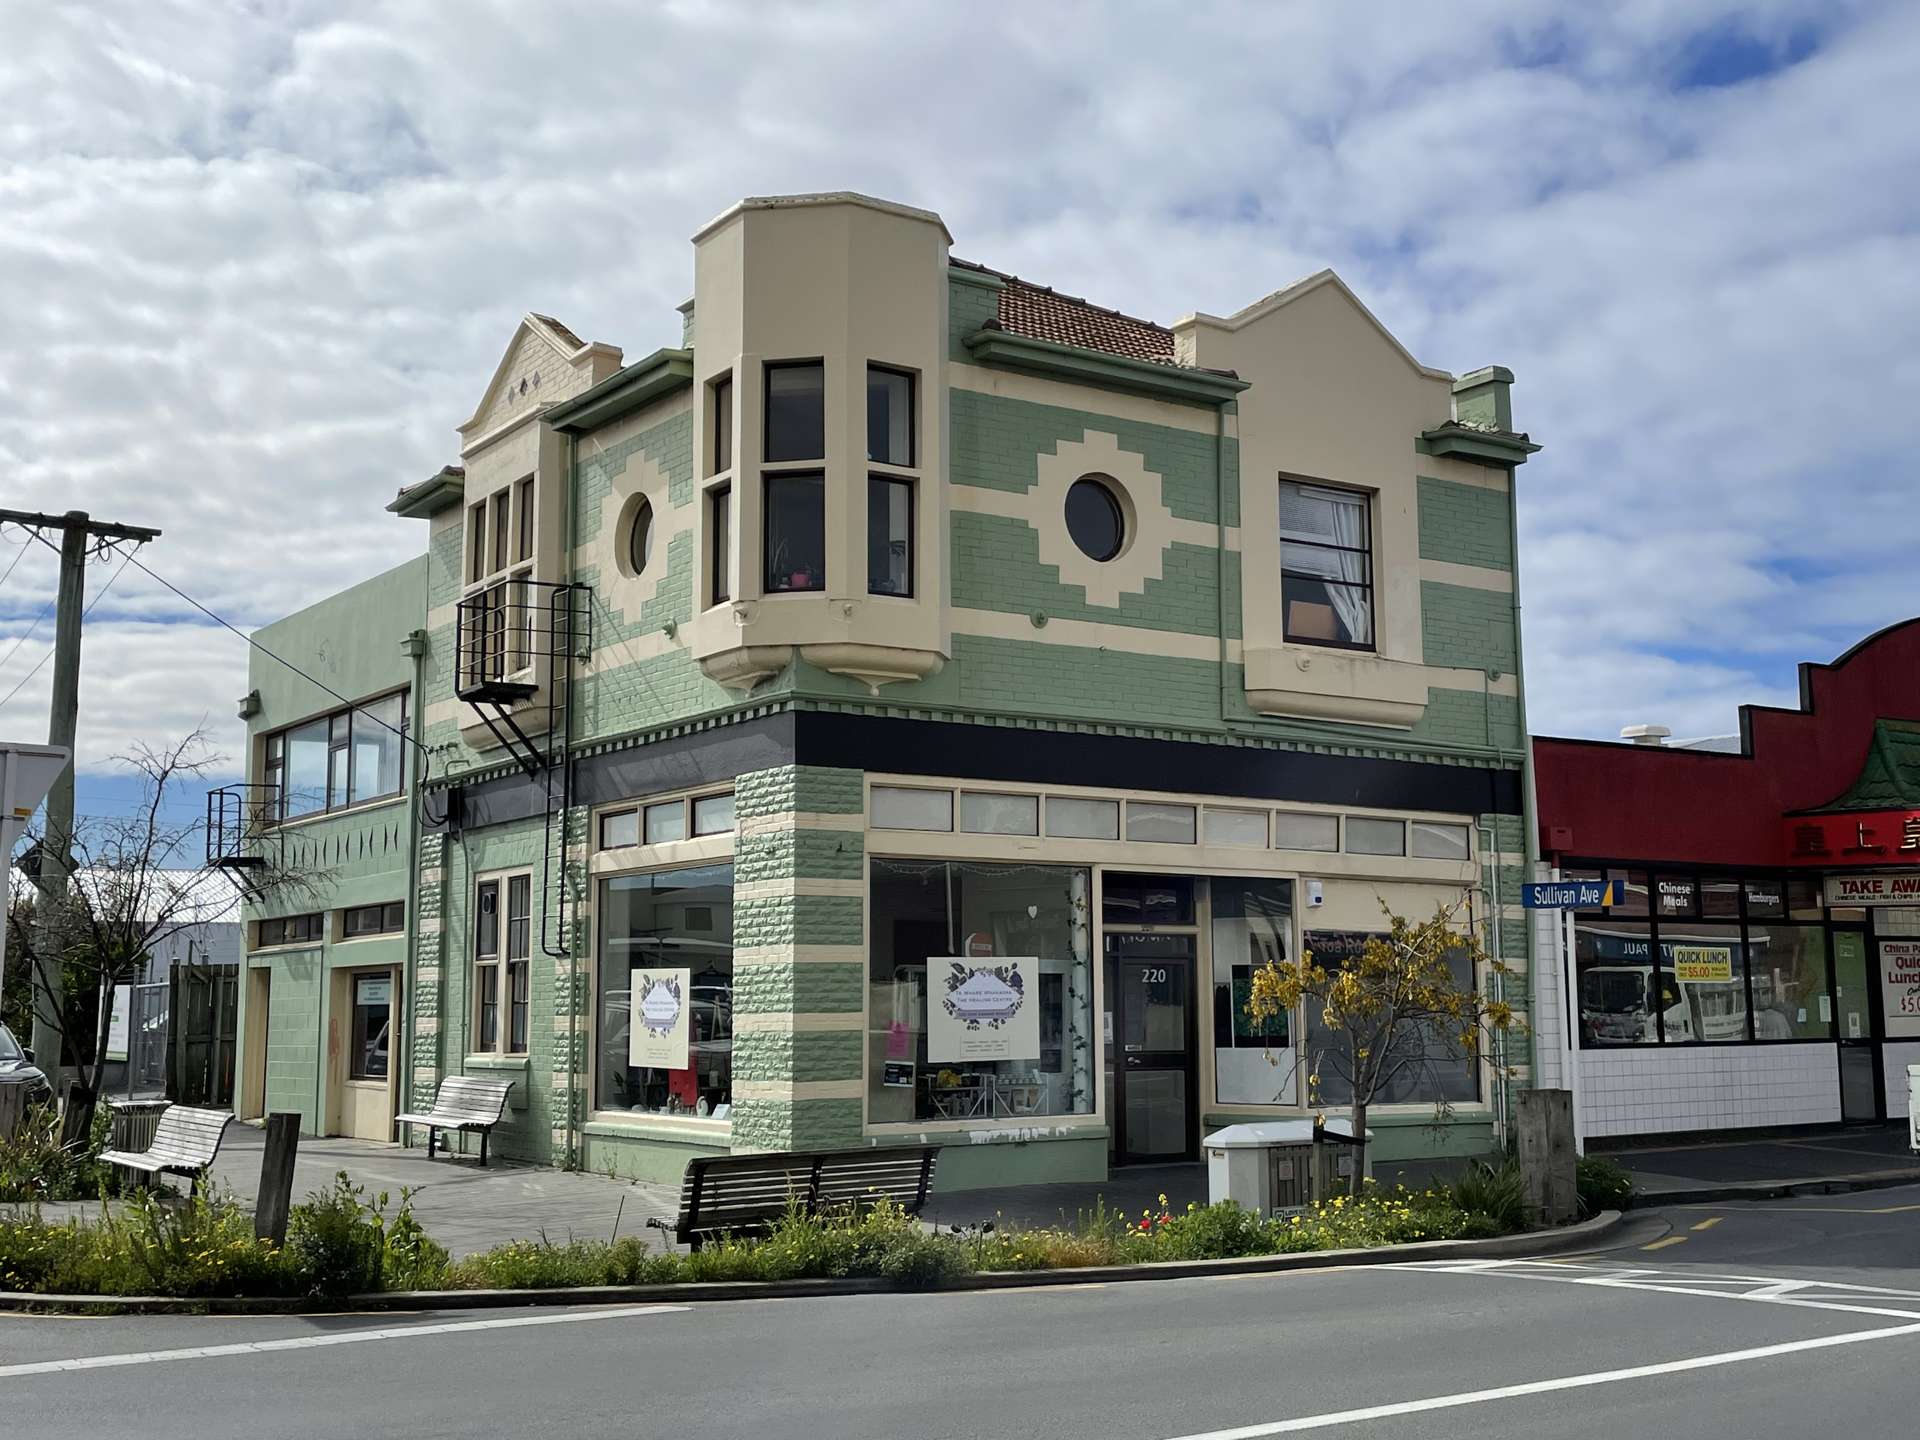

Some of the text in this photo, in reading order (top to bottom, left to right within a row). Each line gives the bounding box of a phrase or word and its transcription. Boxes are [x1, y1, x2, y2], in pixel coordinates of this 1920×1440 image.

[1658, 882, 1691, 894] Chinese
[1840, 880, 1883, 894] TAKE
[1534, 885, 1600, 905] Sullivan Ave
[1663, 895, 1688, 907] Meals
[1748, 892, 1780, 906] Hamburgers
[1884, 944, 1909, 953] China
[1678, 951, 1728, 965] QUICK LUNCH
[1142, 969, 1166, 983] 220
[1687, 967, 1711, 978] $5.00
